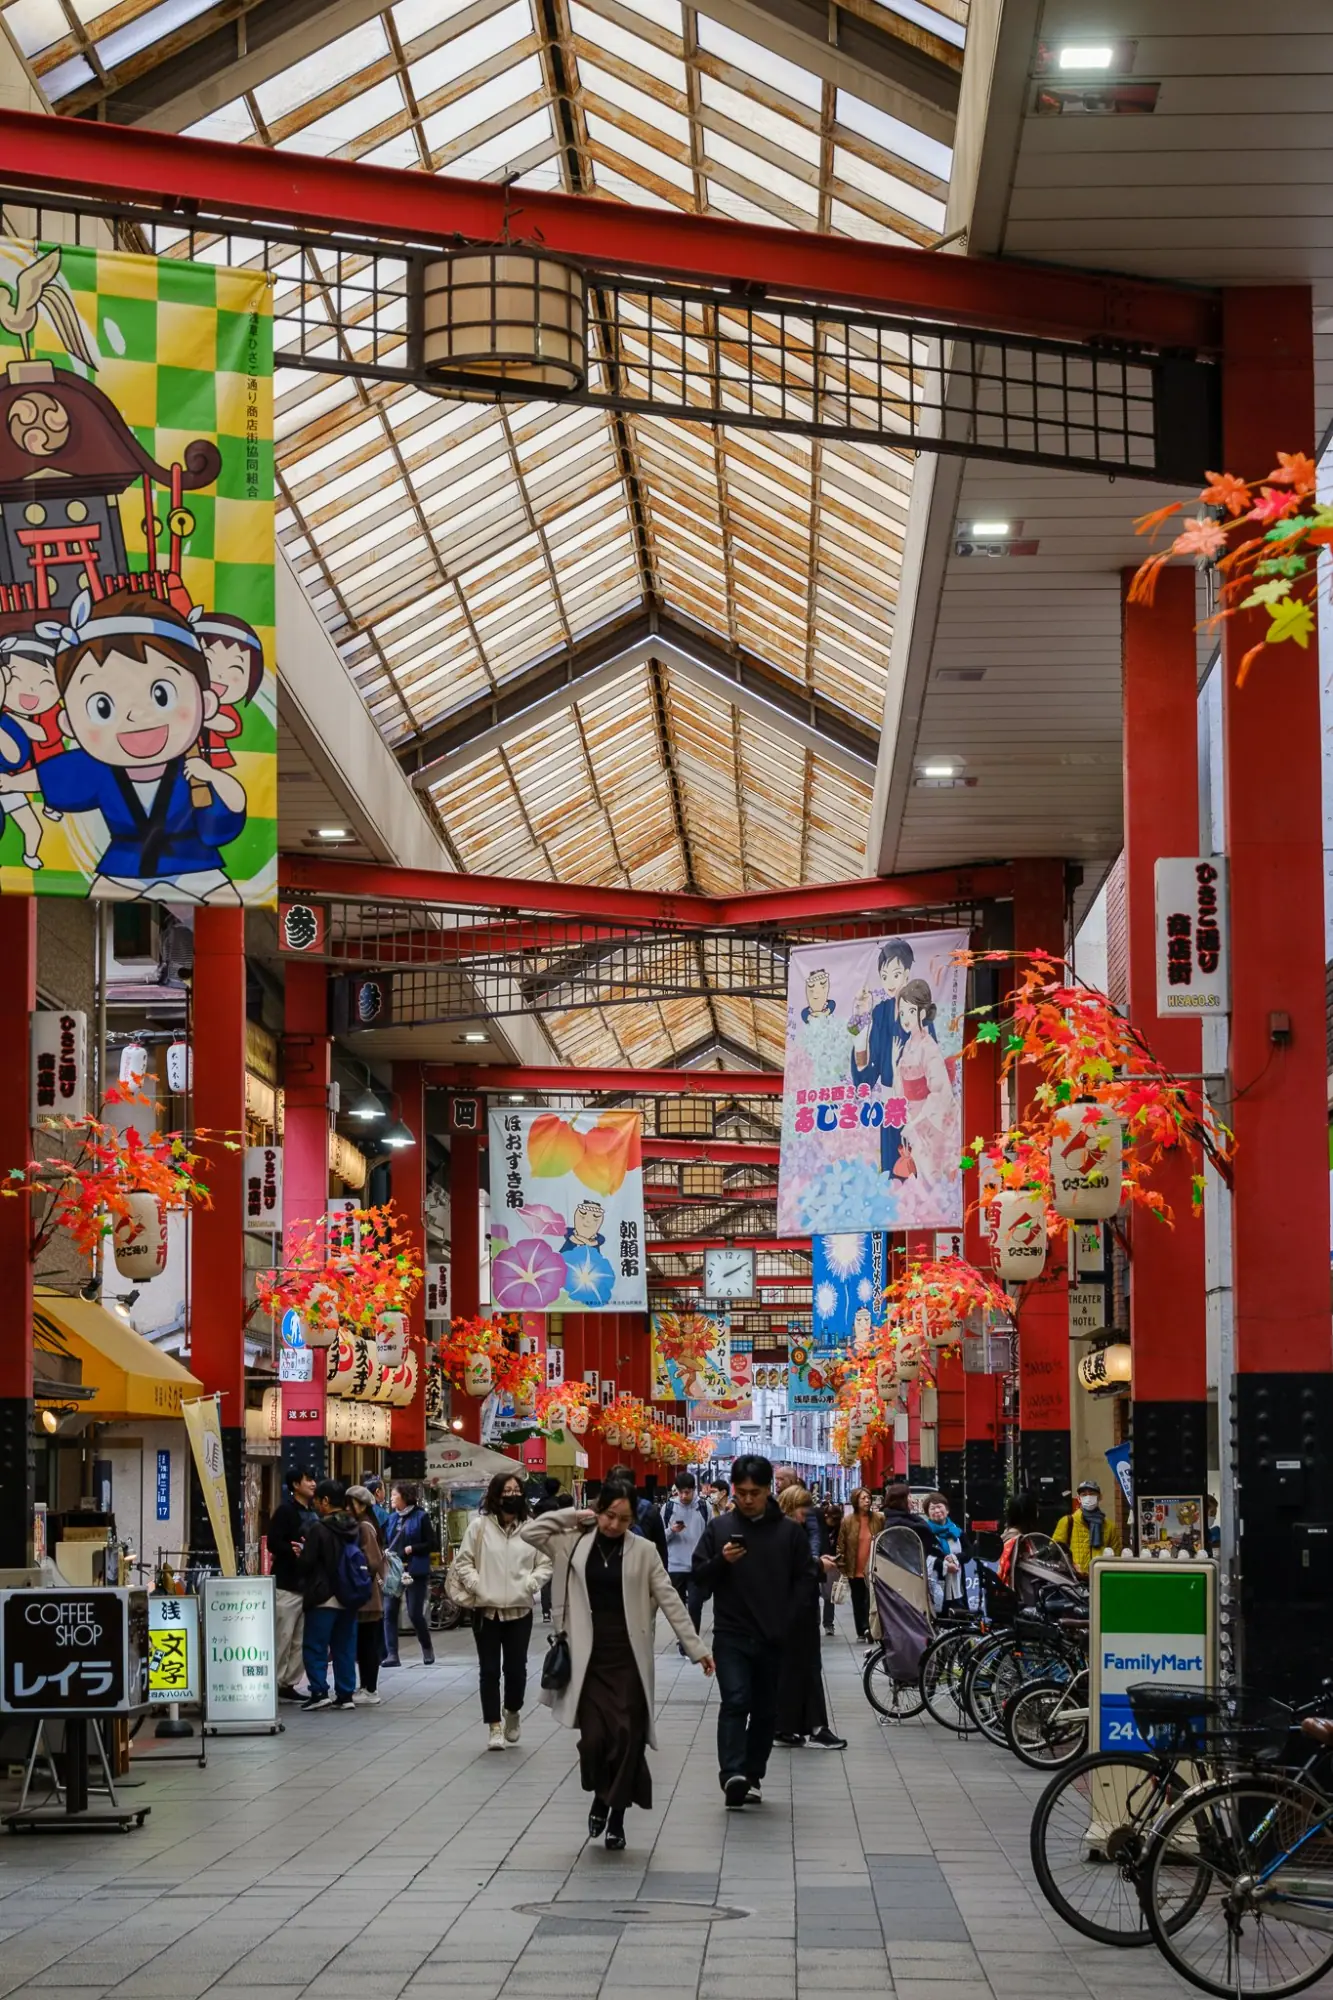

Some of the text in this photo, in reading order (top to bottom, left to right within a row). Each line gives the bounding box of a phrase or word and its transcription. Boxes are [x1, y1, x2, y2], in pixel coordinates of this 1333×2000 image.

[1195, 862, 1220, 974] ひさご通り
[1167, 912, 1192, 986] 商店街
[796, 1084, 871, 1105] 夏のお酉さま
[794, 1098, 908, 1134] あじさい祭
[504, 1115, 524, 1209] ほおずき市
[620, 1220, 639, 1277] 朝顔市
[1068, 1295, 1102, 1304] THEATER
[1072, 1316, 1097, 1326] HOTEL
[158, 1507, 168, 1516] 17
[25, 1602, 95, 1625] COFFEE
[210, 1599, 267, 1615] Comfort
[55, 1624, 103, 1646] SHOP
[211, 1636, 229, 1645] カット
[211, 1646, 270, 1663] 1,000円
[1103, 1652, 1203, 1675] FamilyMart
[13, 1660, 114, 1697] レイラ
[1108, 1721, 1134, 1741] 24
